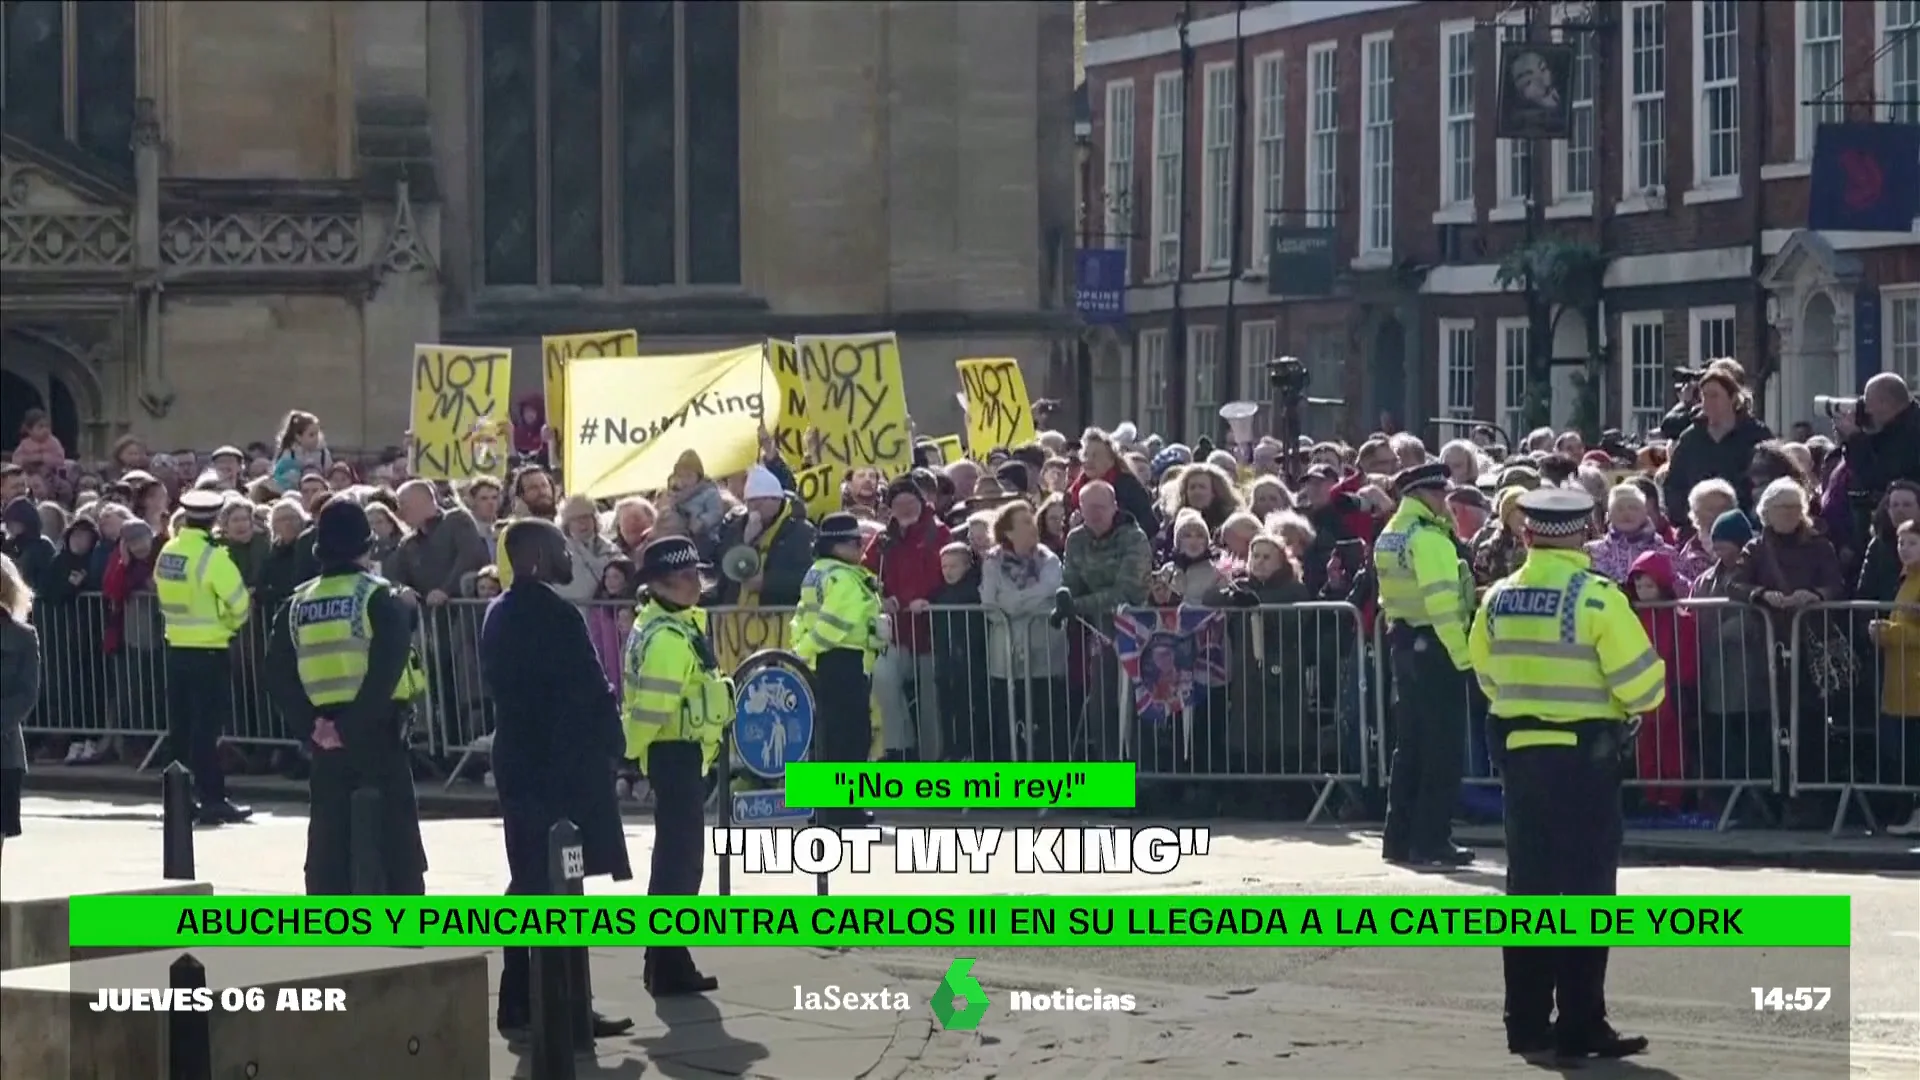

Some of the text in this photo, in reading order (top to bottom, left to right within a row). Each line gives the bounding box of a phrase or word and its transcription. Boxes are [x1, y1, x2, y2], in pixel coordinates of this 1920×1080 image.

[417, 352, 508, 396] NOT
[803, 338, 893, 382] NOT
[823, 377, 889, 431] MY
[961, 362, 1016, 403] NOT
[427, 387, 495, 440] MY
[979, 396, 1021, 447] MY
[815, 423, 905, 466] KING
[799, 465, 833, 502] OT
[299, 598, 350, 621] POLICE
[1498, 590, 1558, 614] POLICE
